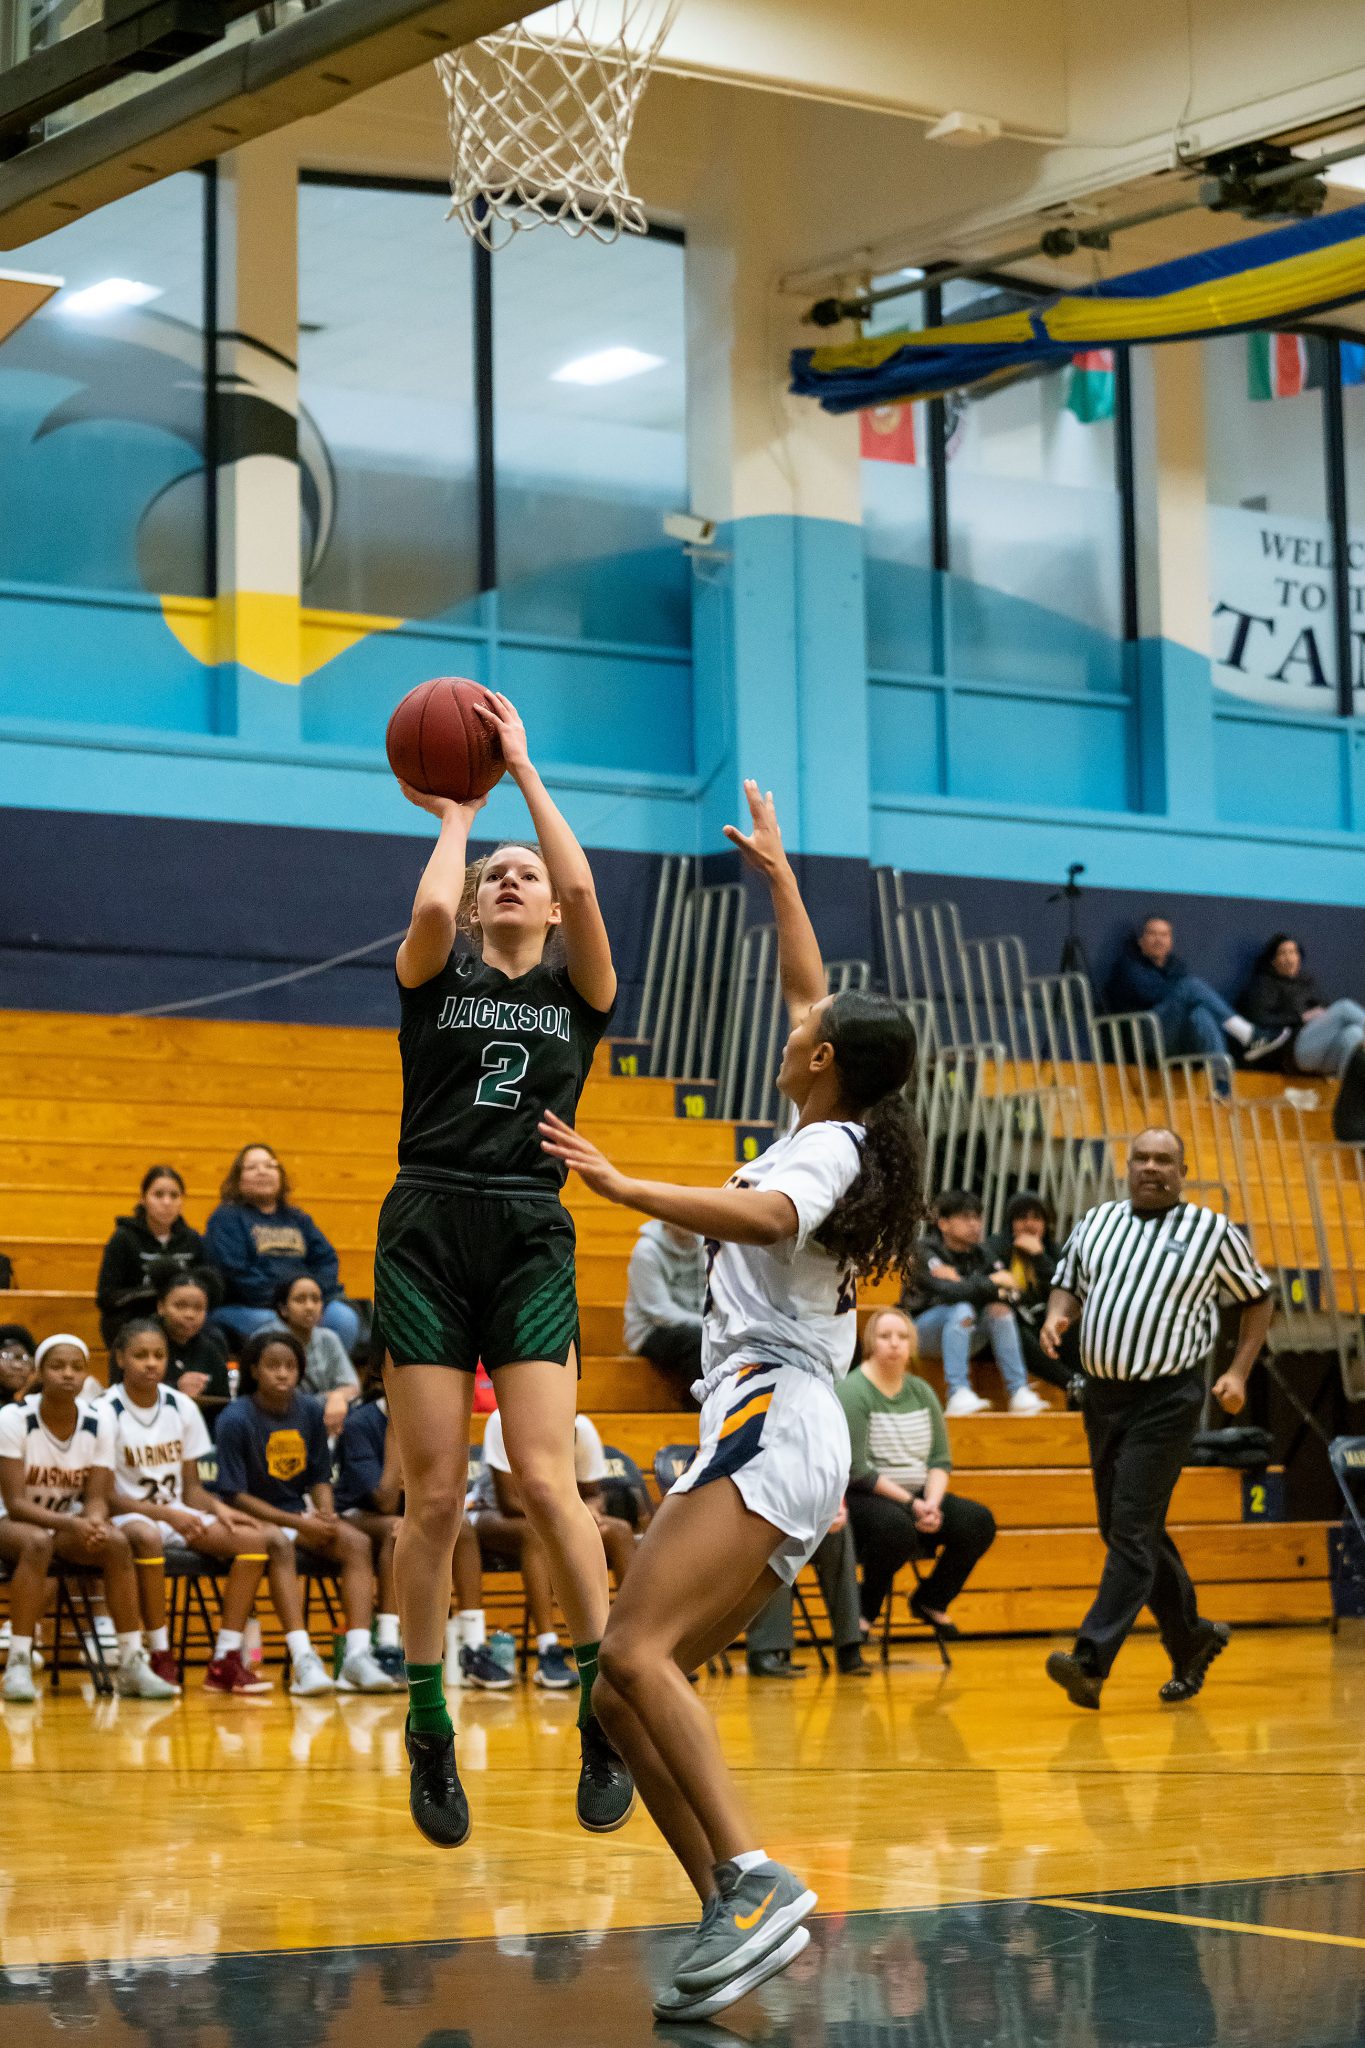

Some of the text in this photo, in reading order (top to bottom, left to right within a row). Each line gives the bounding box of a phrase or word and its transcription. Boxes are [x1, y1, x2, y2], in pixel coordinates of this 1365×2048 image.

[1274, 576, 1326, 612] TO
[1212, 601, 1365, 690] TA
[437, 996, 571, 1042] JACKSON
[473, 1041, 530, 1110] 2
[1250, 1485, 1266, 1513] 2
